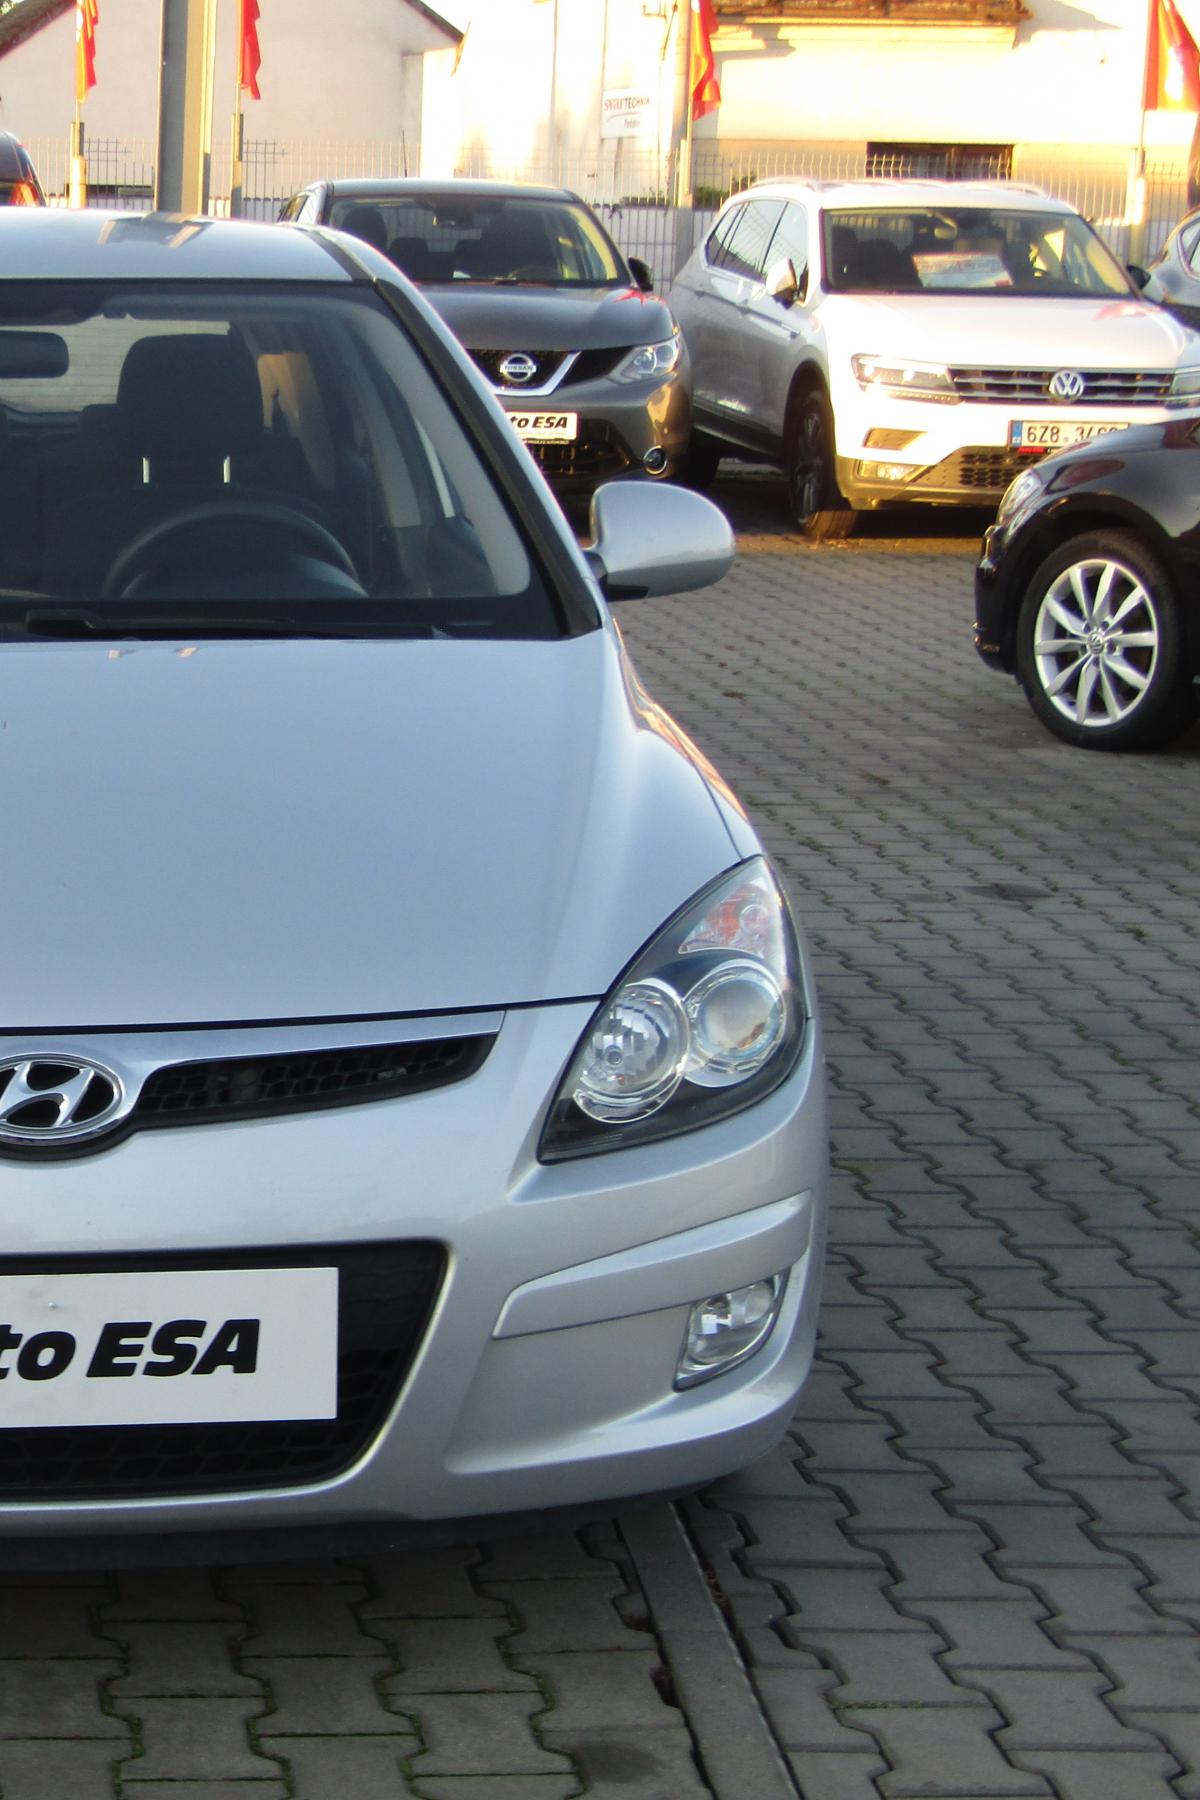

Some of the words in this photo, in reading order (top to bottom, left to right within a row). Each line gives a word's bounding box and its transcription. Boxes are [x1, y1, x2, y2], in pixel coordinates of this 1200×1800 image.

[532, 416, 568, 428] ESA
[1027, 426, 1060, 443] 6Z8
[86, 1319, 260, 1378] ESA
